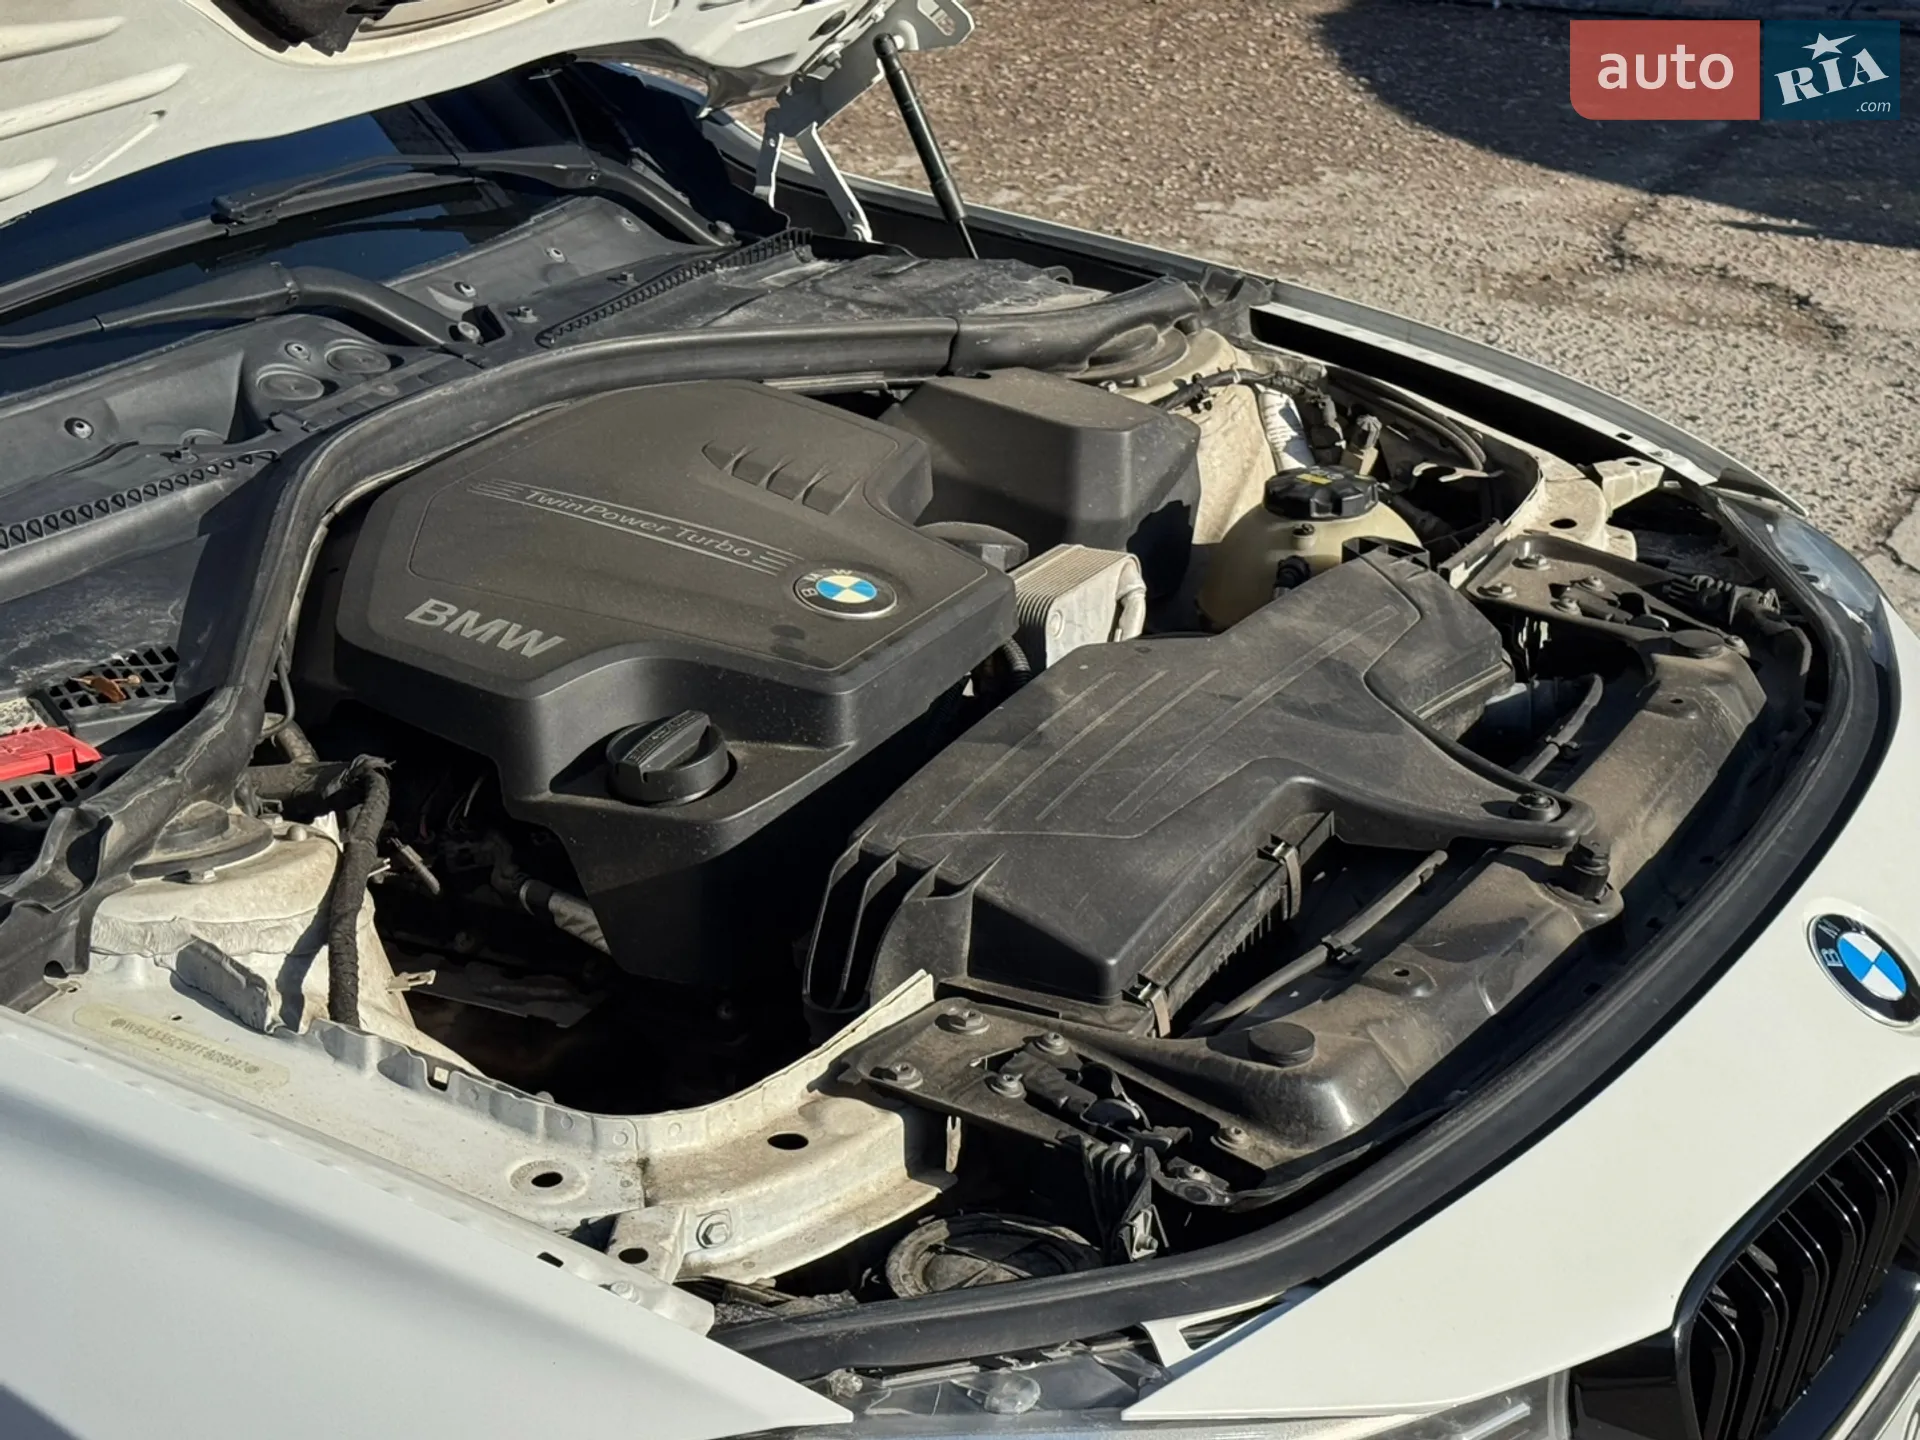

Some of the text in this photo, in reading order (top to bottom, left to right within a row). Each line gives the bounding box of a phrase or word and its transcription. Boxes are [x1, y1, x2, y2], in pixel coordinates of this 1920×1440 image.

[524, 489, 753, 558] TwinPower Turbo
[404, 597, 566, 659] BMW
